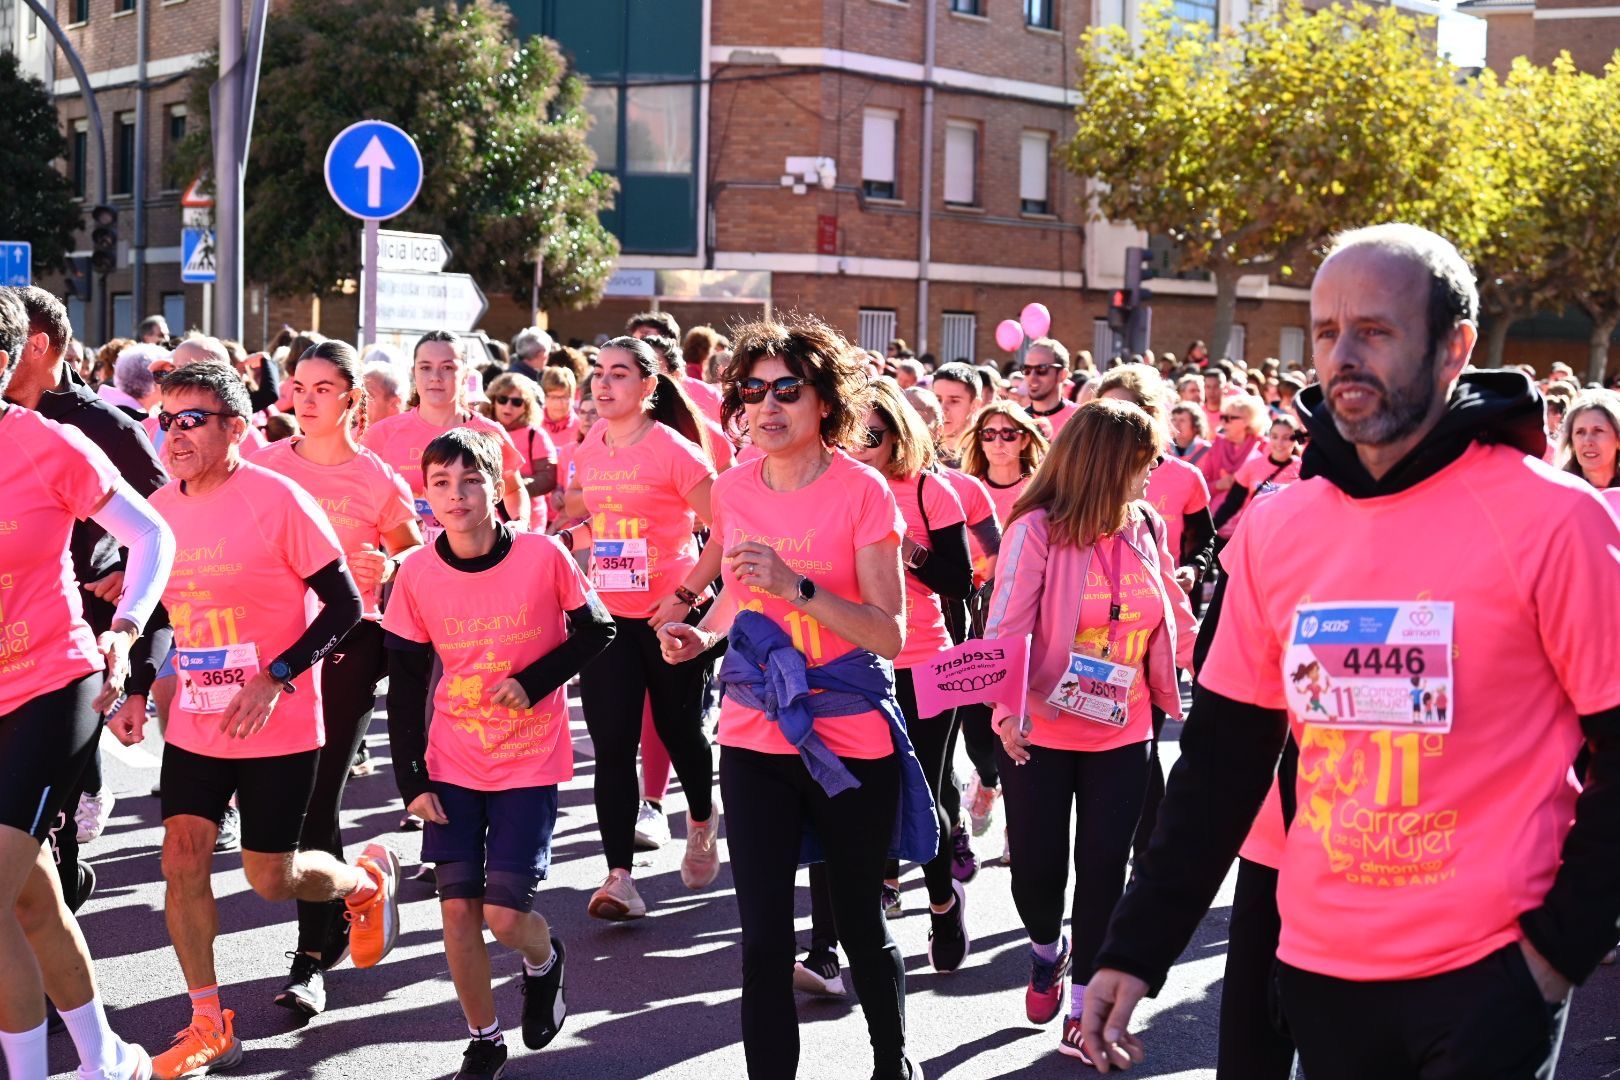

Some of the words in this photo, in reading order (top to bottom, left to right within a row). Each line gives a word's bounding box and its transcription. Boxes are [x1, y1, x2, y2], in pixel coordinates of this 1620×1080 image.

[411, 241, 440, 262] local
[603, 558, 634, 569] 3547
[783, 559, 833, 571] AROBELS
[500, 627, 542, 643] CAROBELS
[473, 661, 512, 670] SUZUKI
[1343, 647, 1425, 675] 4446
[203, 668, 246, 686] 3652
[1091, 680, 1117, 698] 1503
[491, 747, 550, 759] DRASANVI
[501, 741, 529, 750] almom
[1340, 799, 1458, 836] Carrera
[1362, 829, 1455, 863] Mujer
[1360, 860, 1419, 873] almom
[1346, 868, 1456, 887] DRASANVI
